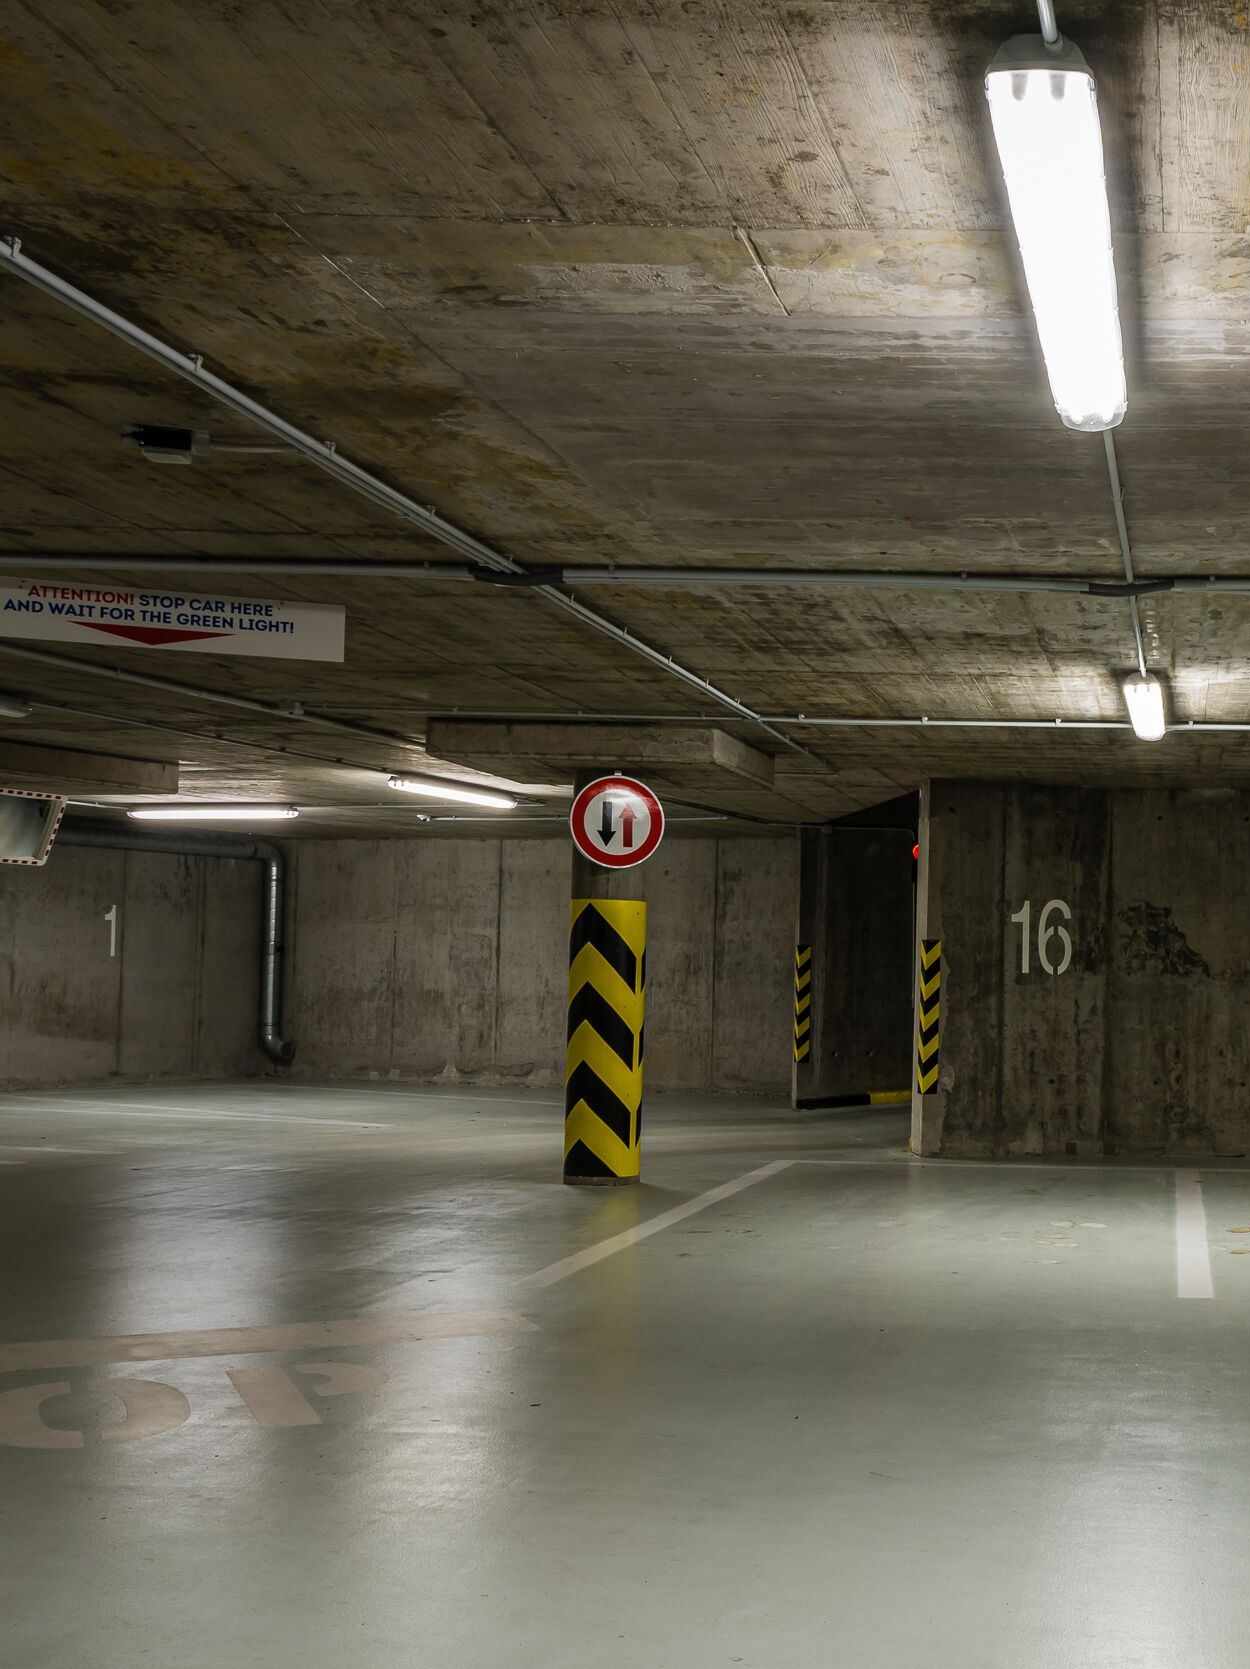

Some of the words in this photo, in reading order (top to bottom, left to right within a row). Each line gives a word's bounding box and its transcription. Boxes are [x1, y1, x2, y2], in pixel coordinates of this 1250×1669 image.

[3, 599, 44, 613] AND
[48, 602, 95, 618] WAIT
[100, 606, 135, 621] FOR
[139, 610, 172, 624] THE
[176, 613, 234, 629] GREEN
[239, 618, 294, 634] LIGHT!
[27, 585, 134, 606] ATTENTION!
[139, 594, 186, 610] STOP
[189, 599, 226, 613] CAR
[230, 602, 274, 617] HERE
[104, 903, 117, 958] 1
[1011, 899, 1072, 976] 16
